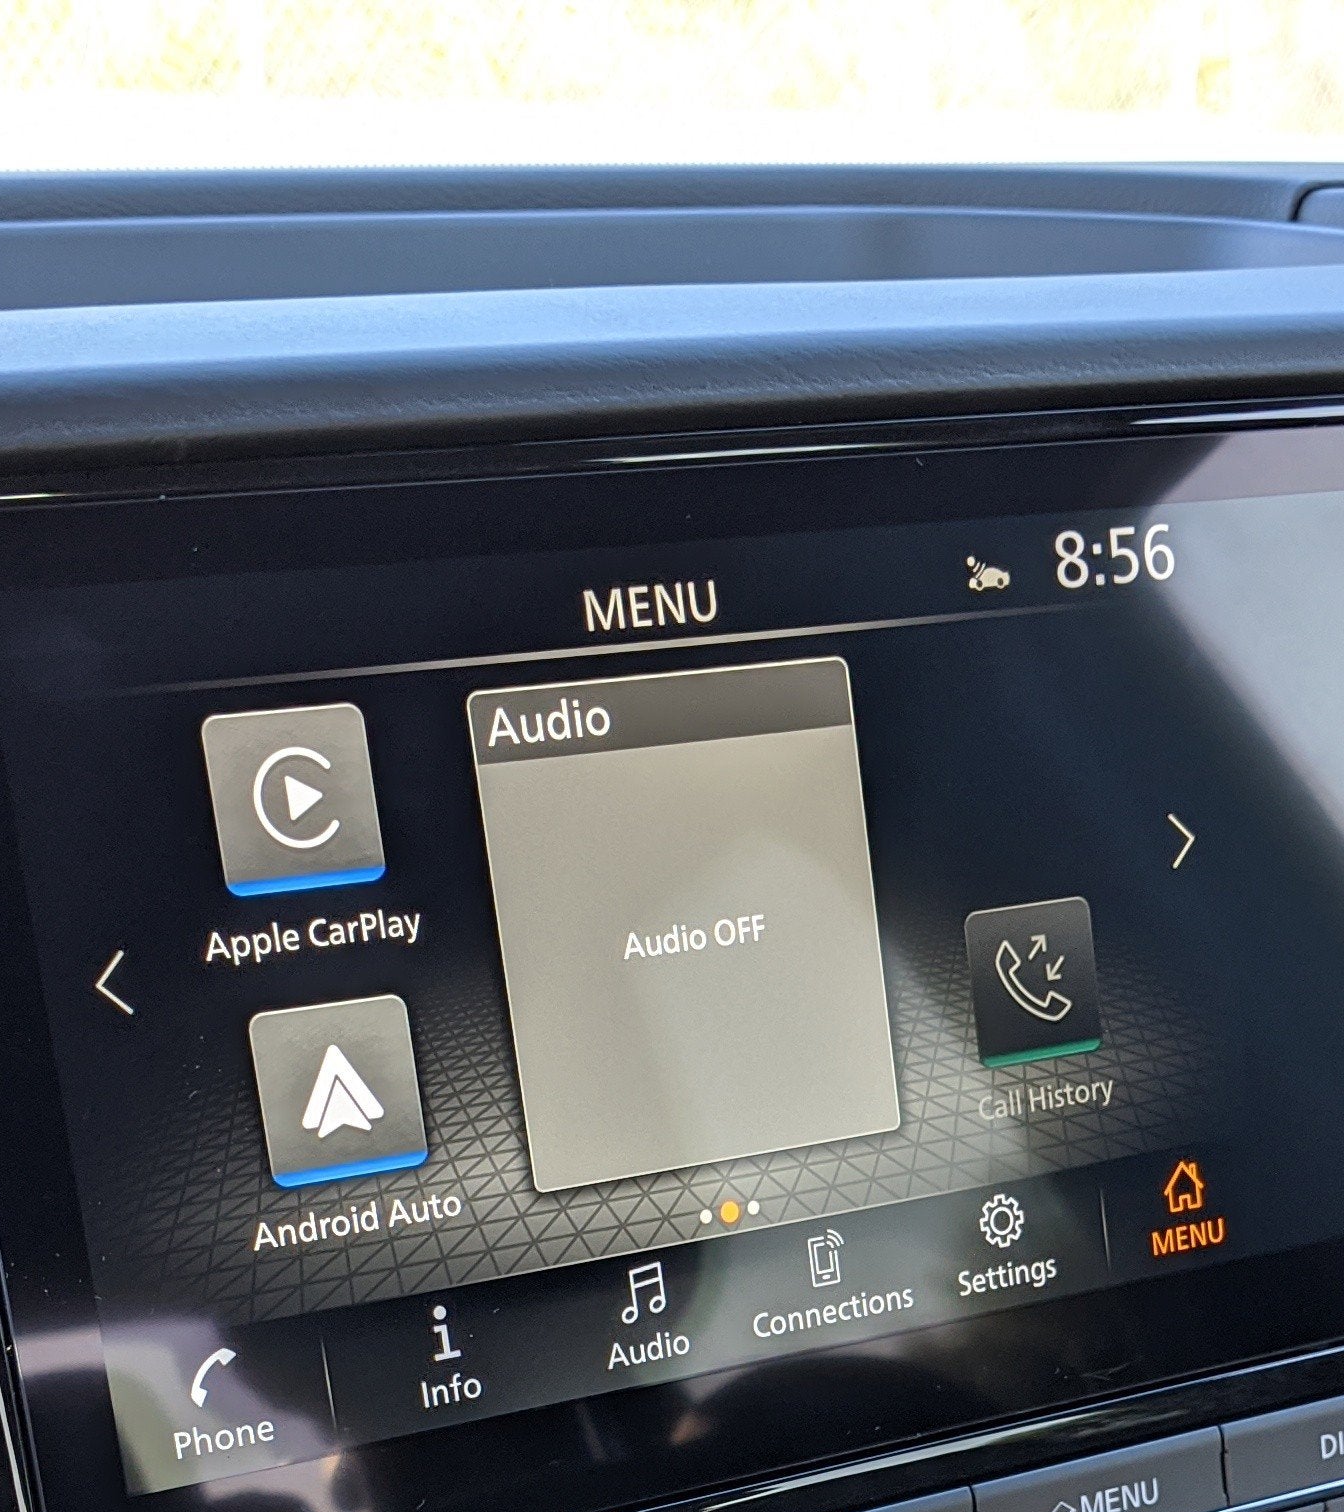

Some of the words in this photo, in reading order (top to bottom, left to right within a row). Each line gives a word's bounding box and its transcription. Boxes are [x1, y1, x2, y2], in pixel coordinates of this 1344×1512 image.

[1055, 523, 1175, 589] 8:56
[582, 578, 720, 633] MENU
[487, 697, 612, 748] Audio
[205, 921, 301, 966] Apple
[307, 908, 422, 955] CarPlay
[622, 924, 708, 961] Audio
[714, 912, 767, 947] OFF
[976, 1087, 1023, 1122] Call
[1029, 1075, 1114, 1118] History
[253, 1200, 379, 1253] Android
[385, 1192, 463, 1230] Auto
[1151, 1216, 1226, 1257] MENU
[957, 1254, 1058, 1298] Settings
[752, 1285, 914, 1339] Connections
[607, 1328, 691, 1371] Audio
[421, 1372, 483, 1410] Info
[172, 1415, 276, 1462] Phone
